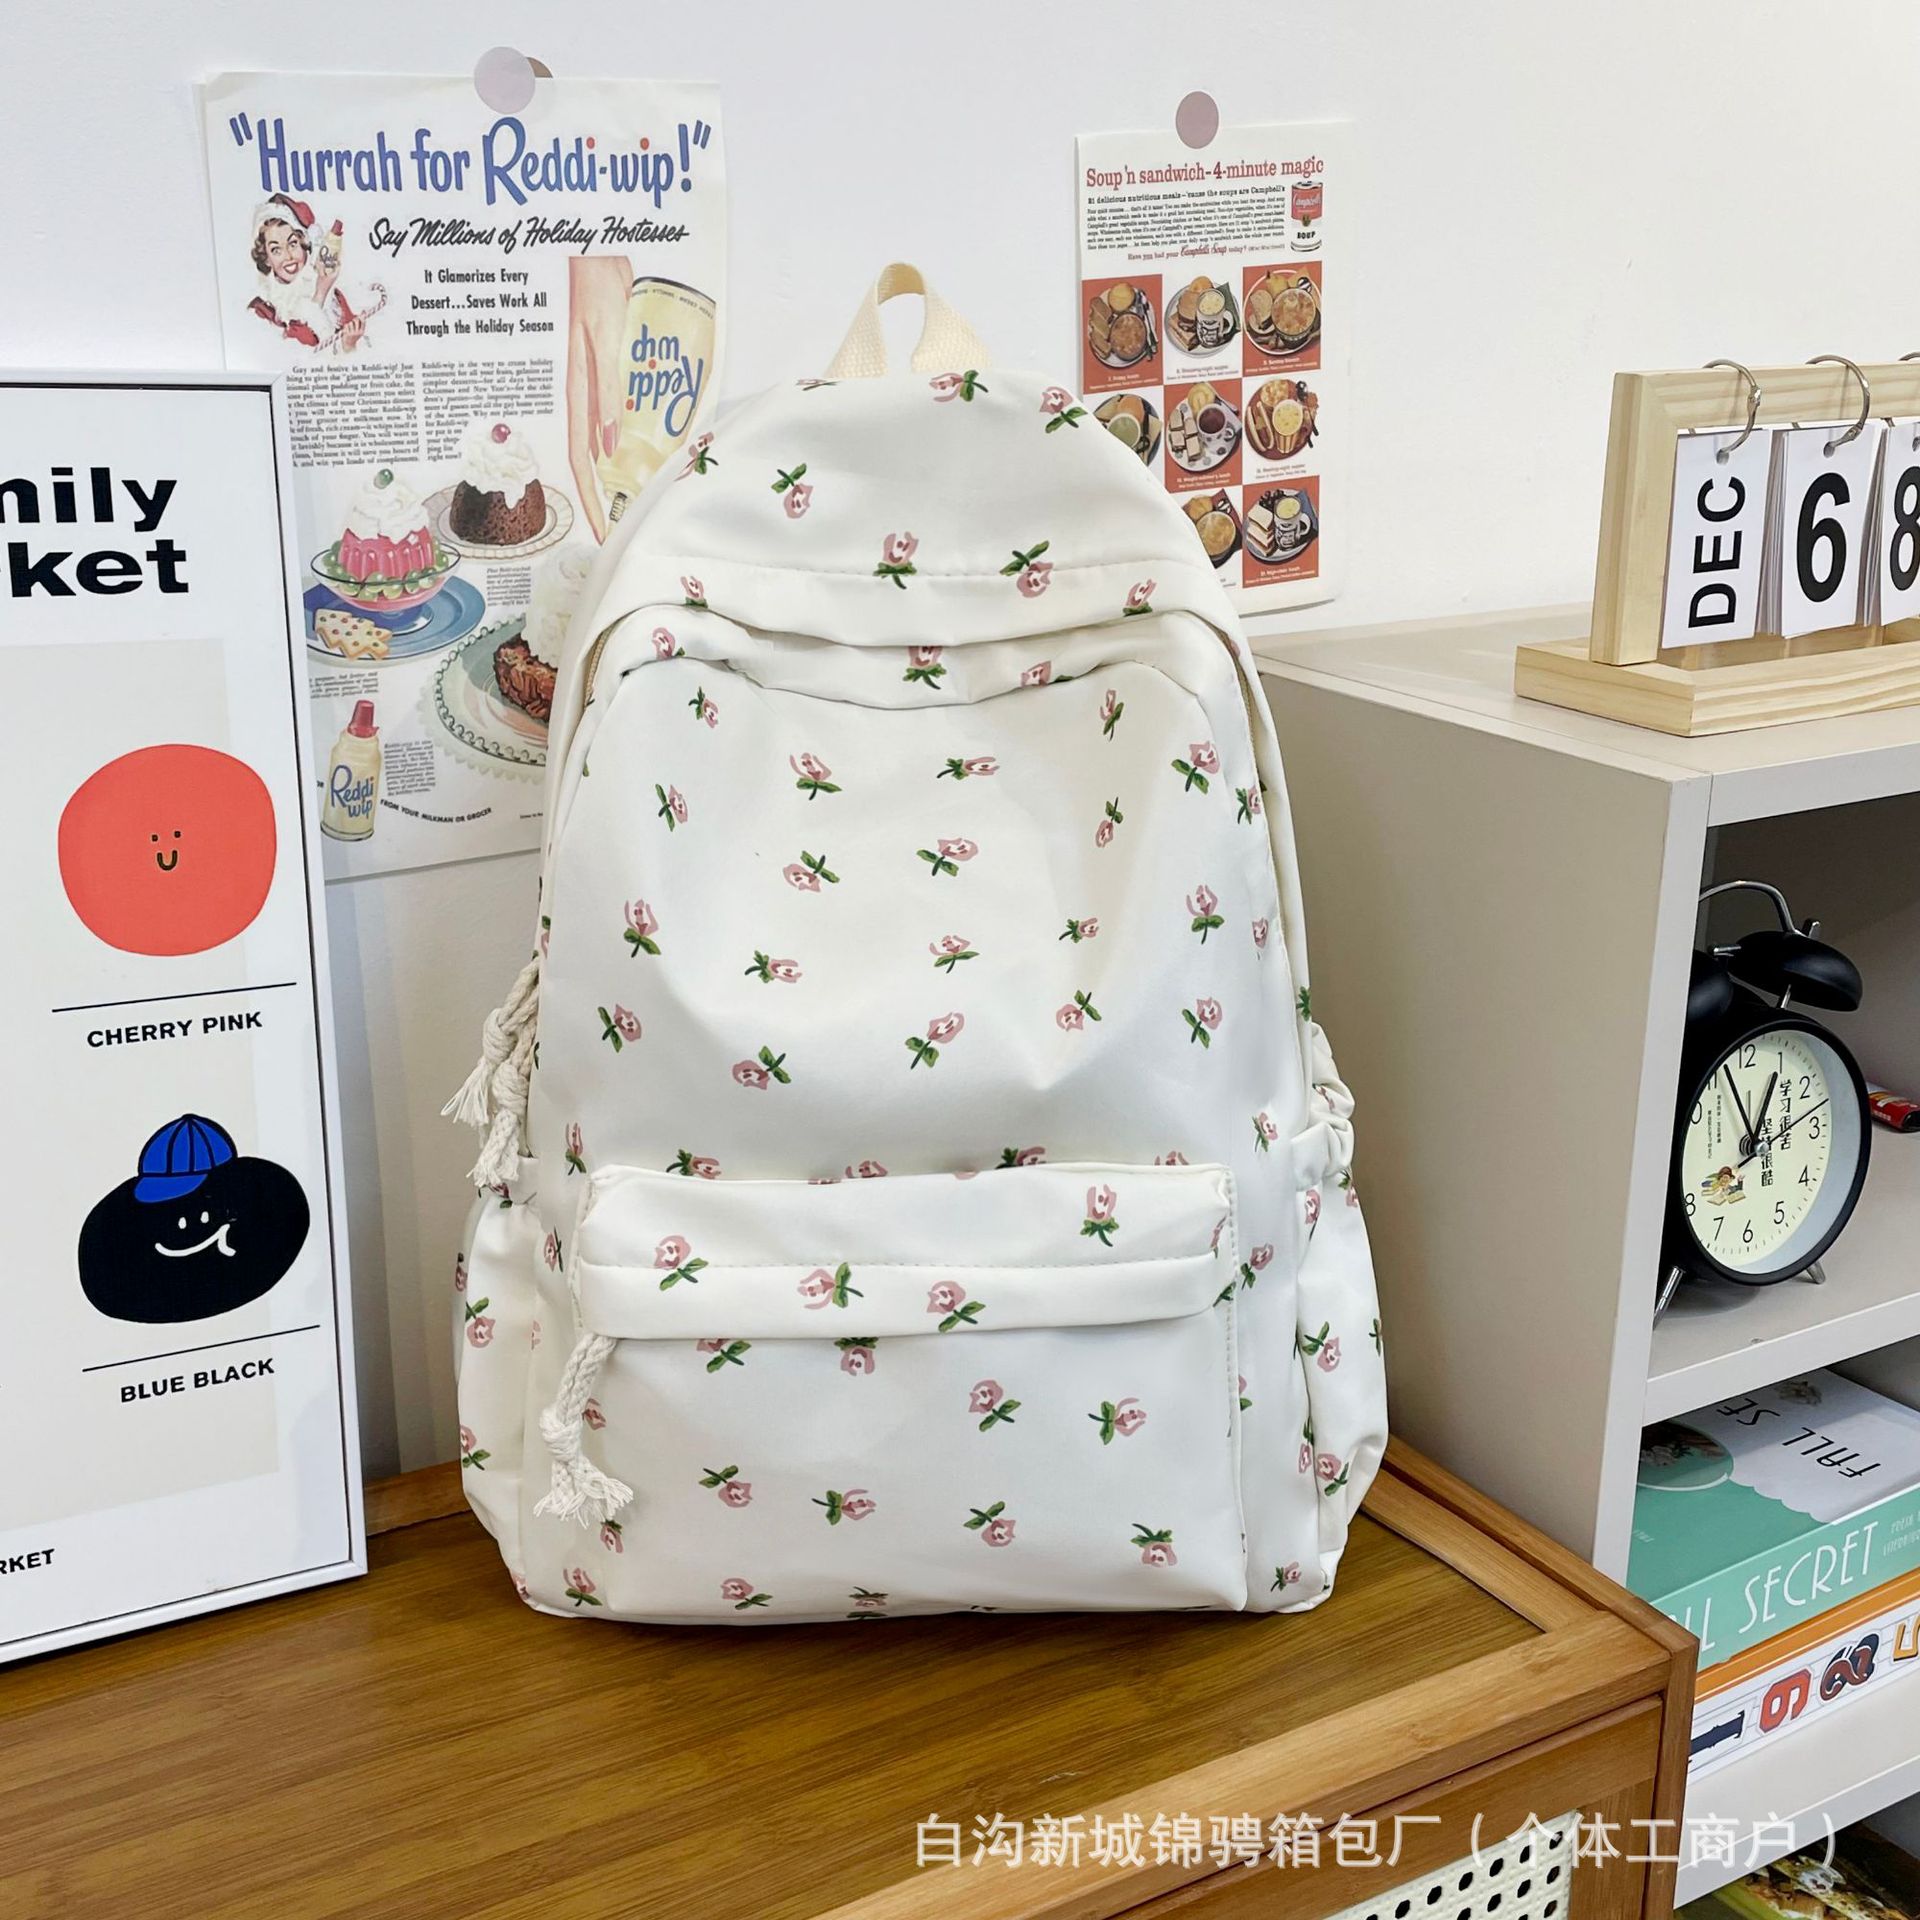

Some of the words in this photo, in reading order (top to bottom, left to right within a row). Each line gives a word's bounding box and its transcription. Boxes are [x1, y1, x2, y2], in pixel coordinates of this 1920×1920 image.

[410, 128, 470, 192] for
[1086, 167, 1122, 191] Soup
[1281, 155, 1324, 178] magic
[1096, 195, 1126, 204] delicious
[1127, 193, 1161, 202] nutritious
[1207, 189, 1217, 197] the
[1250, 184, 1285, 195] Campbell's
[369, 217, 408, 258] Say
[409, 217, 496, 247] Millions
[498, 220, 522, 254] of
[523, 216, 598, 255] Holiday
[600, 216, 690, 244] Hostesses
[1297, 230, 1316, 240] SOUP
[424, 269, 432, 283] It
[438, 268, 496, 284] Glamorizes
[500, 268, 529, 286] Every
[500, 292, 528, 308] Work
[533, 291, 547, 307] All
[406, 319, 450, 338] Through
[454, 319, 471, 334] the
[475, 318, 514, 336] Holiday
[519, 318, 554, 333] Season
[631, 323, 680, 369] wip
[625, 355, 704, 437] Reddi
[1796, 472, 1850, 603] 6
[1890, 466, 1920, 591] 8
[1688, 476, 1746, 628] DEC
[8, 539, 189, 597] ket
[330, 765, 374, 808] Reddi
[348, 799, 373, 819] wip
[380, 798, 399, 811] FROM
[401, 806, 420, 818] YOUR
[421, 813, 453, 823] MILKMAN
[455, 814, 466, 823] OR
[466, 807, 492, 821] GROCER
[87, 1020, 193, 1047] CHERRY
[202, 1011, 263, 1034] PINK
[1738, 1043, 1756, 1069] 12
[1777, 1051, 1783, 1074] 1
[1799, 1076, 1811, 1099] 2
[1809, 1116, 1820, 1139] 3
[1798, 1165, 1810, 1187] 4
[1685, 1193, 1696, 1217] 8
[1773, 1201, 1785, 1224] 5
[1713, 1216, 1724, 1241] 7
[1742, 1219, 1753, 1243] 6
[121, 1376, 185, 1403] BLUE
[193, 1358, 275, 1388] BLACK
[1782, 1427, 1881, 1478] FALL
[1738, 1521, 1878, 1634] SECRET
